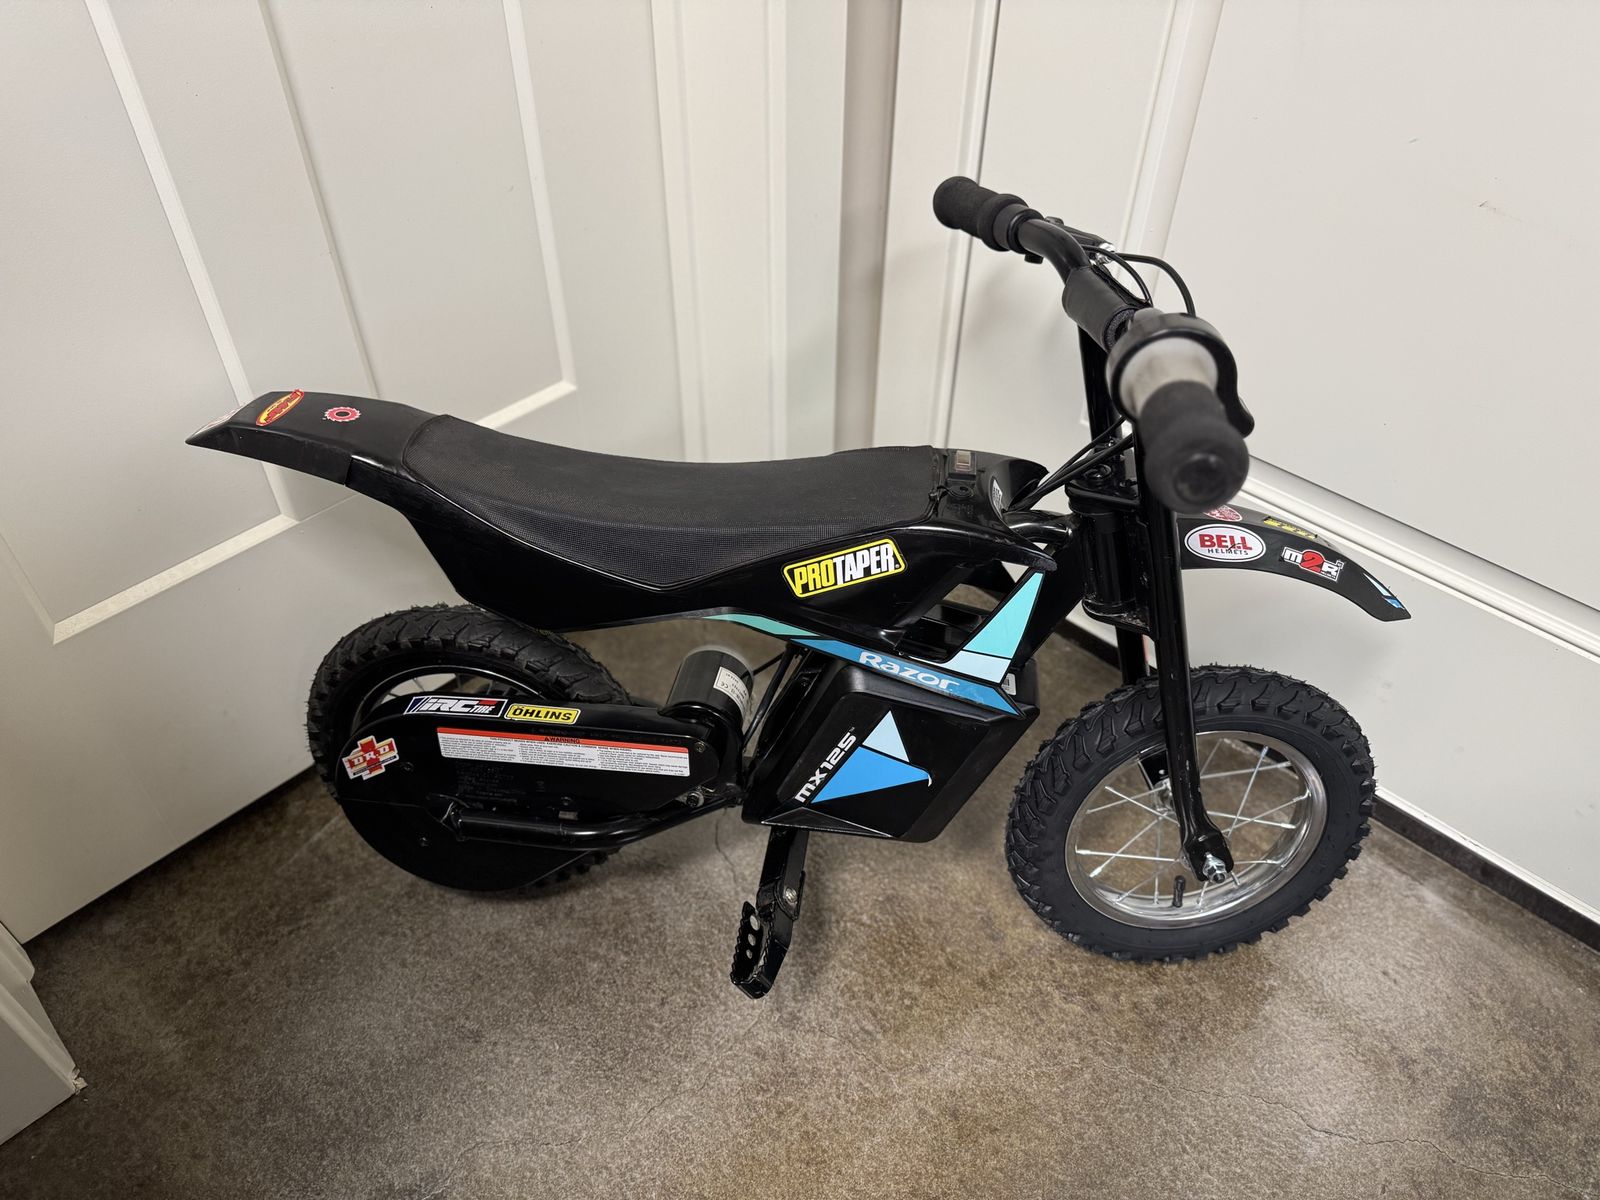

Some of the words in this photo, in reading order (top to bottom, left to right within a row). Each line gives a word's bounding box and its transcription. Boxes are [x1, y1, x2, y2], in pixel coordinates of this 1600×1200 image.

[1199, 534, 1252, 551] BELL
[1207, 548, 1249, 556] HELMETS
[859, 651, 960, 689] Razor
[469, 704, 496, 714] TIRE
[512, 706, 573, 721] ÖHLINS
[550, 736, 580, 745] WARNING
